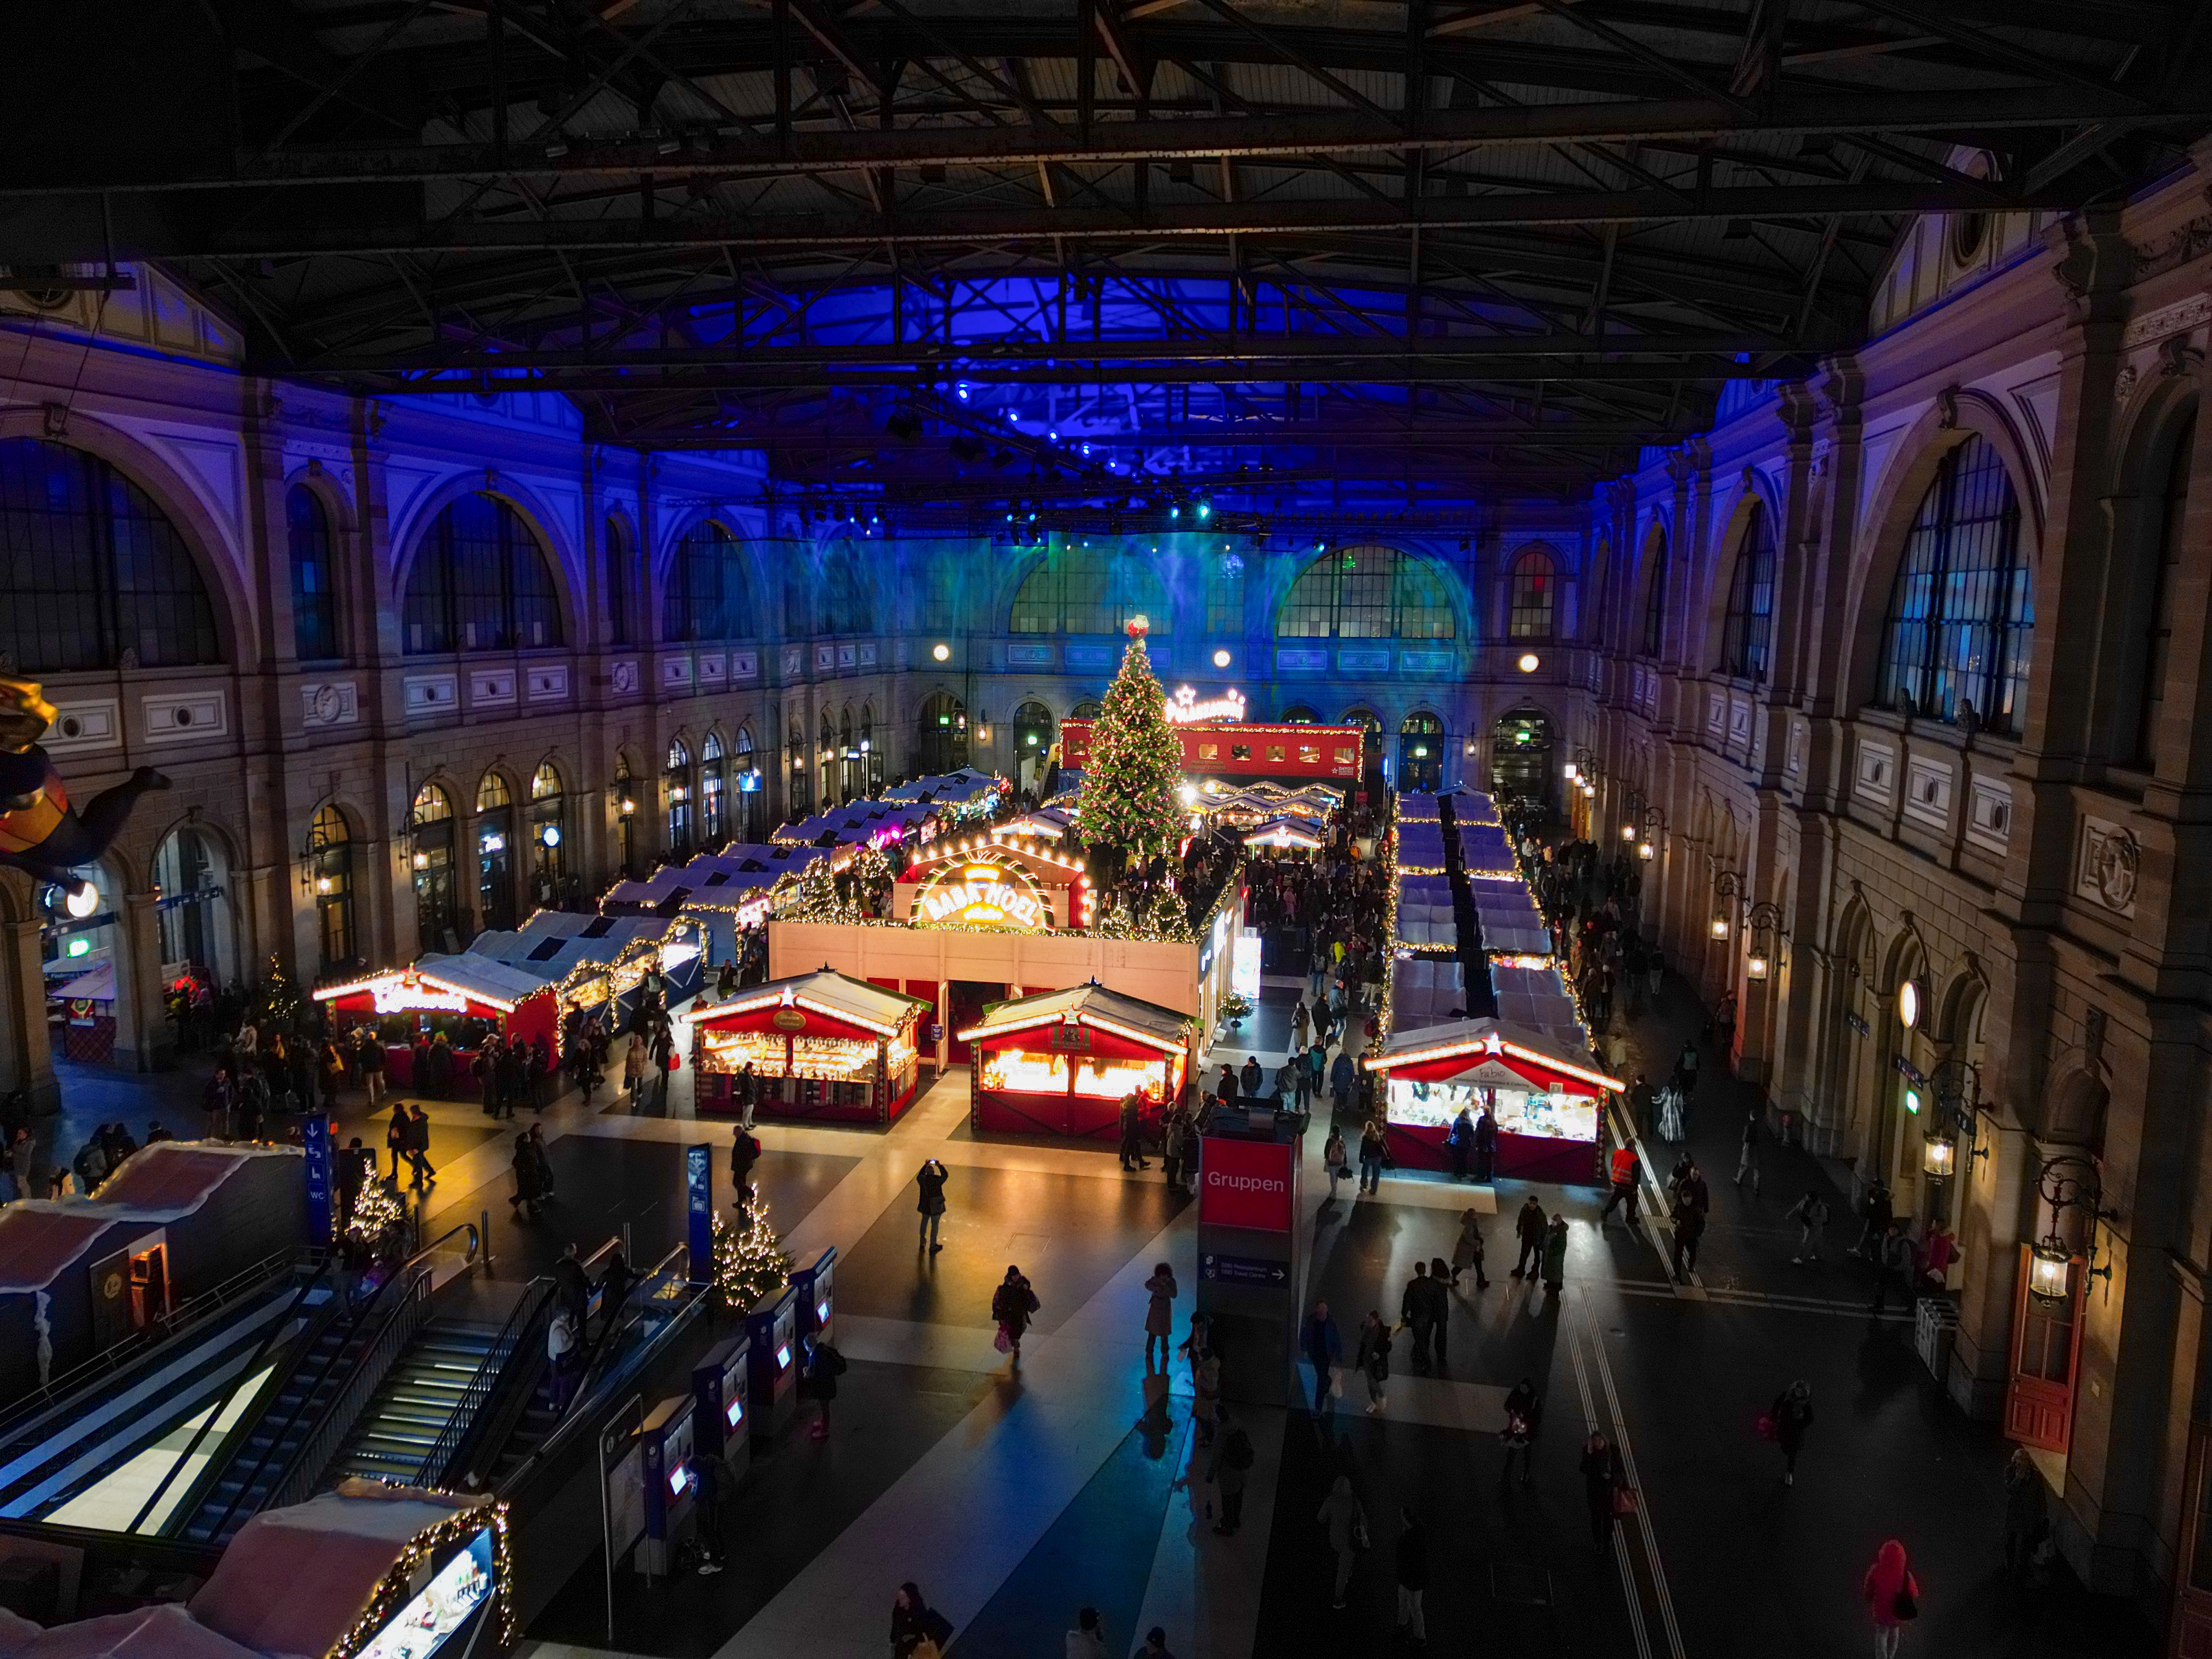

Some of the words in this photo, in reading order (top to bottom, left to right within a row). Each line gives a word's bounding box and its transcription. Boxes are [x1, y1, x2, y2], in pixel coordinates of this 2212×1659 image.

[1479, 1066, 1505, 1077] Fabio
[1207, 1171, 1284, 1192] Gruppen
[310, 1191, 325, 1200] WC
